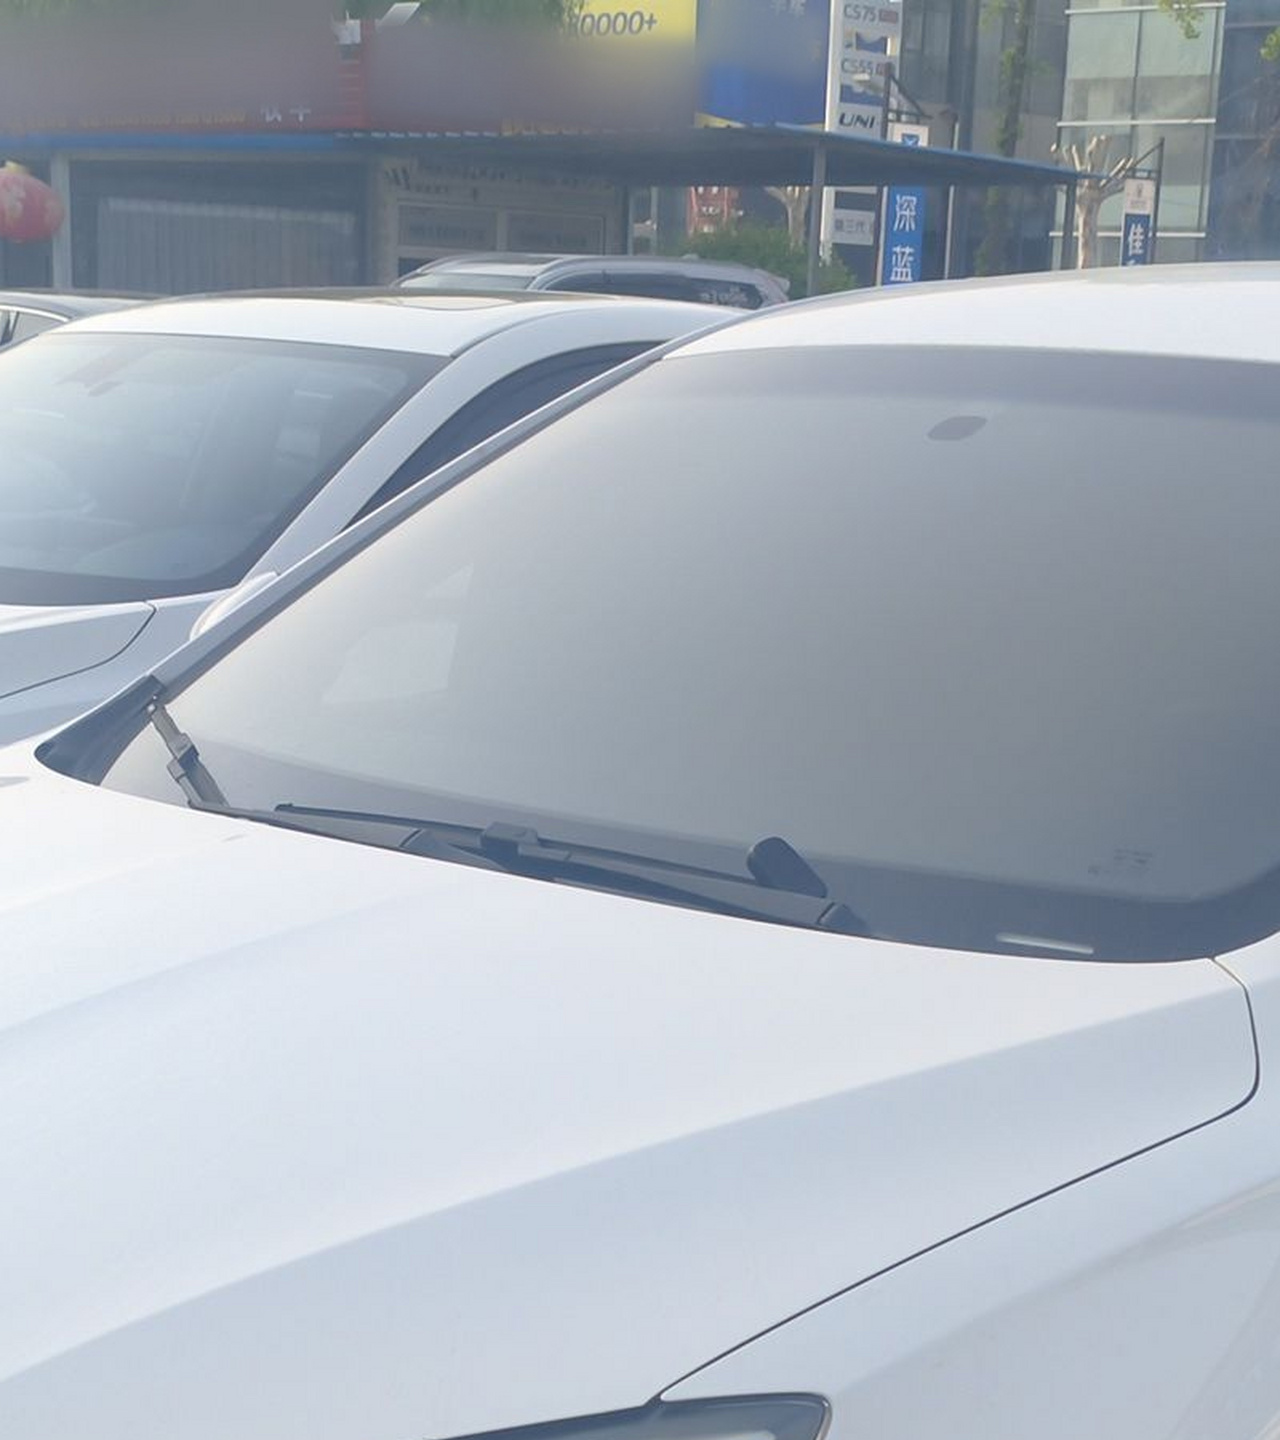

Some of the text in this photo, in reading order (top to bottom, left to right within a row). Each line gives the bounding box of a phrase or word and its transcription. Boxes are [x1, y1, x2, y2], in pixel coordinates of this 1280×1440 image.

[838, 112, 876, 129] UNI
[889, 194, 918, 282] 深蓝
[1127, 223, 1145, 265] 佳
